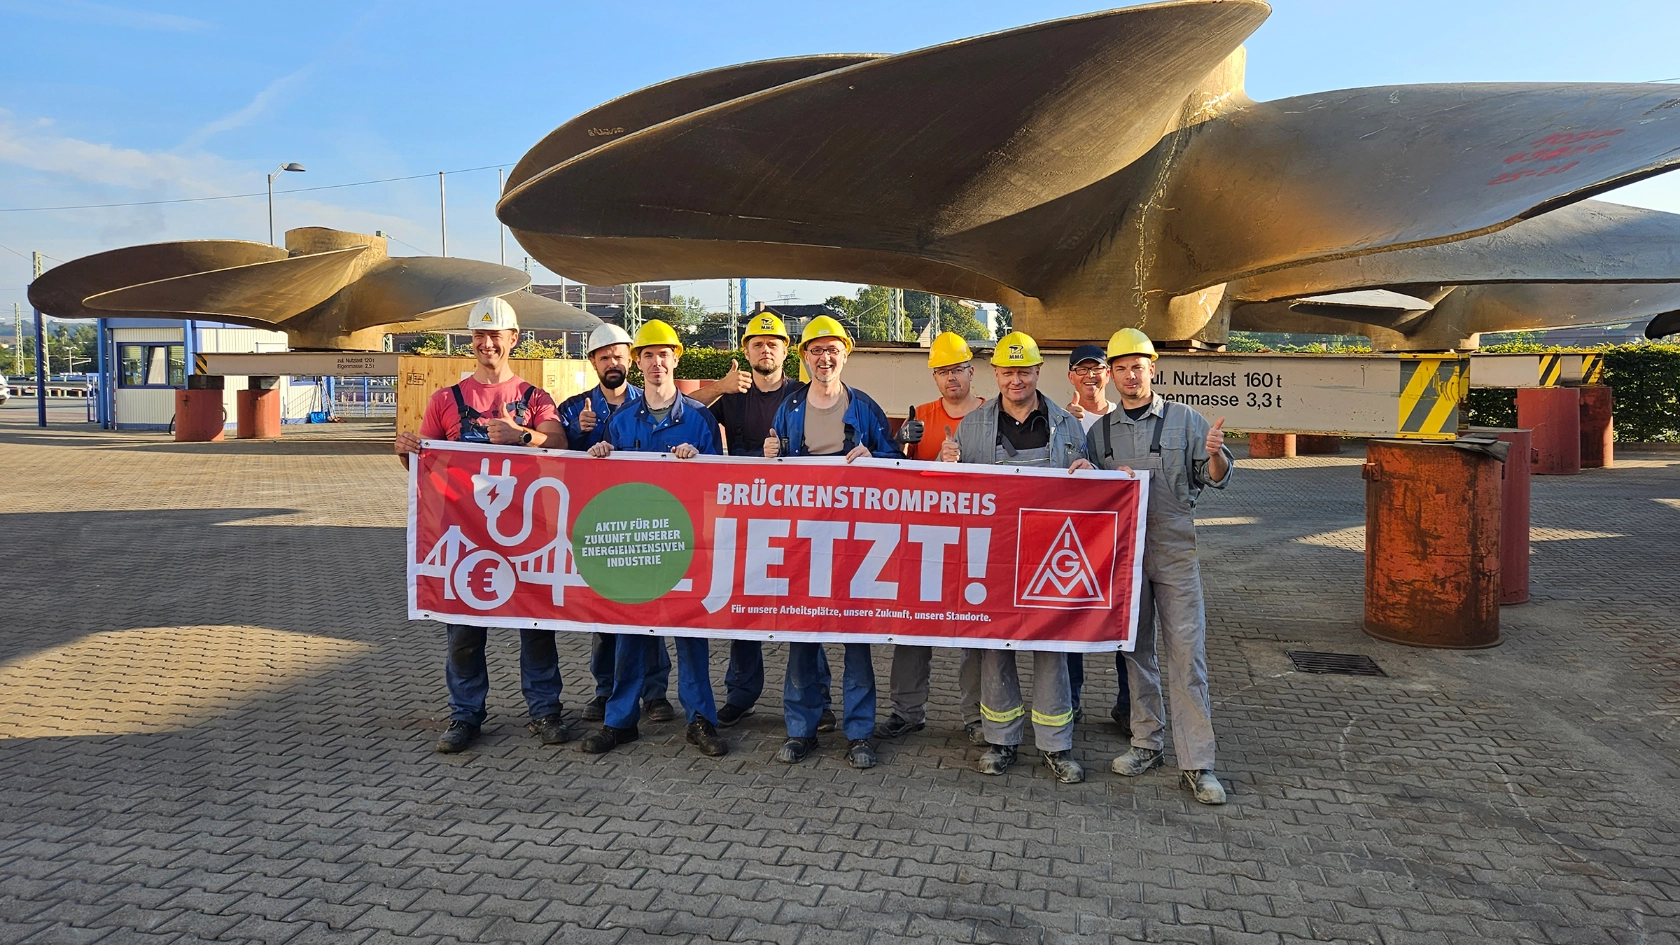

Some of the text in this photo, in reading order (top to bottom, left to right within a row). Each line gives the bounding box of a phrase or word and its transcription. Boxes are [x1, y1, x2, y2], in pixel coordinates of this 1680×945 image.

[1173, 370, 1237, 387] Nutzlast
[1243, 372, 1273, 388] 160
[1276, 374, 1282, 388] t
[1246, 392, 1272, 410] 3,3
[1276, 394, 1282, 408] t
[716, 477, 996, 516] BRÜCKENSTROMPREIS
[595, 518, 669, 532] AKTIV FÜR DIE
[584, 529, 680, 545] ZUKUNFT UNSERER
[581, 541, 686, 557] ENERGIEINTENSIVEN
[606, 555, 662, 568] INDUSTRIE
[700, 517, 992, 615] JETZT!
[731, 604, 992, 622] Für unsere Arbeitsplätze, unsere Zukunft, unsere Standorte.
